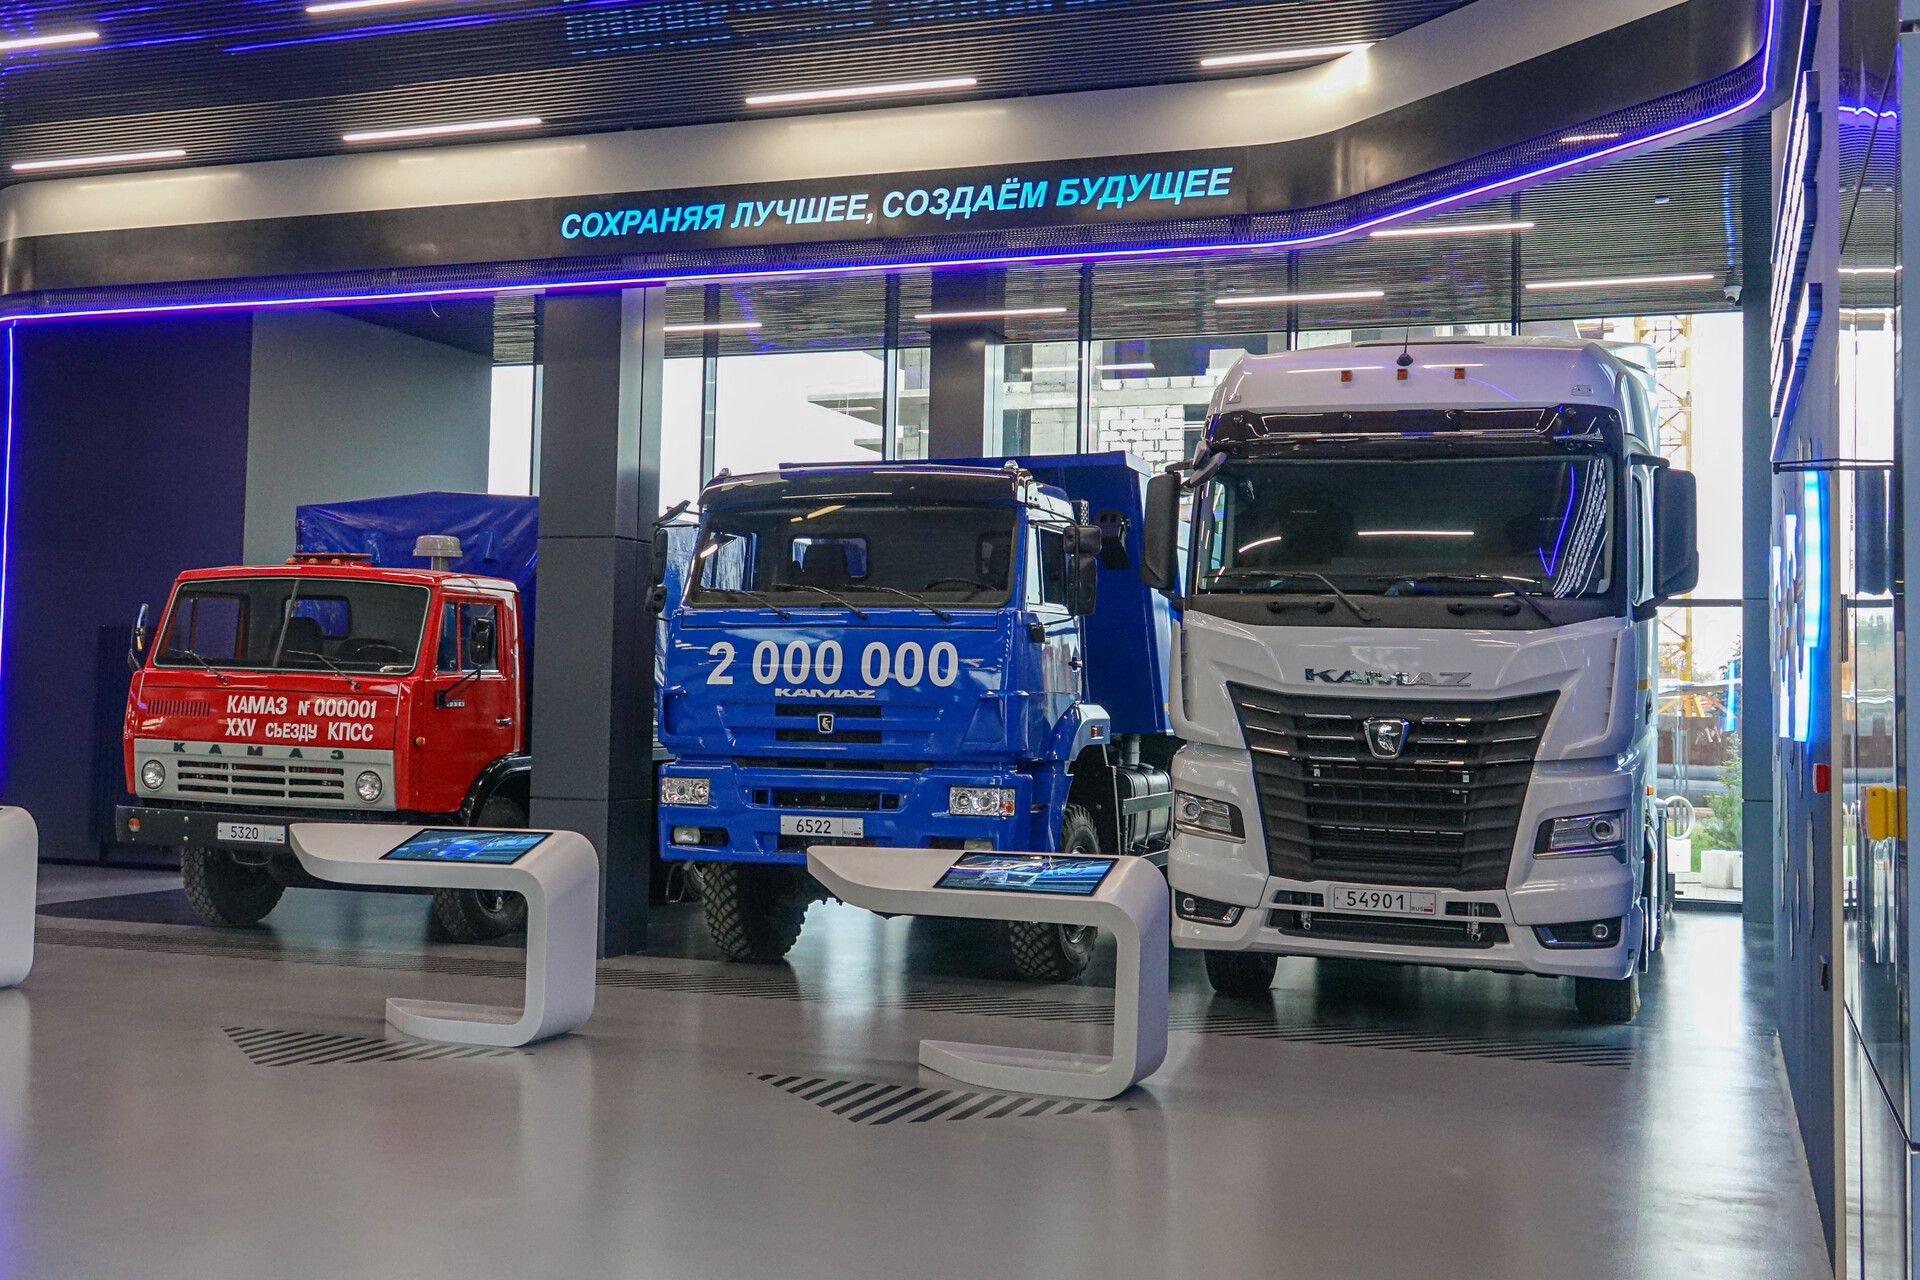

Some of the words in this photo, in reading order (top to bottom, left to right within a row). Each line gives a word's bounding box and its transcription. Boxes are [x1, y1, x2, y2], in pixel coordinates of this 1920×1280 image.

[561, 203, 725, 239] СОХРАНЯЯ
[730, 193, 874, 228] ЛУЧШЕЕ,
[882, 177, 1048, 220] СОЗДАЁМ
[1056, 166, 1233, 210] БУДУЩЕЕ
[706, 641, 735, 685] 2
[752, 640, 843, 685] 000
[861, 641, 959, 687] 000
[1304, 668, 1472, 687] KAMAZ
[775, 688, 876, 699] KAMAZ
[226, 695, 288, 715] КАМАЗ
[314, 698, 377, 719] 000001
[327, 721, 374, 741] КПСС
[230, 825, 259, 840] 5320
[796, 818, 831, 834] 6522
[1346, 890, 1404, 910] 54901
